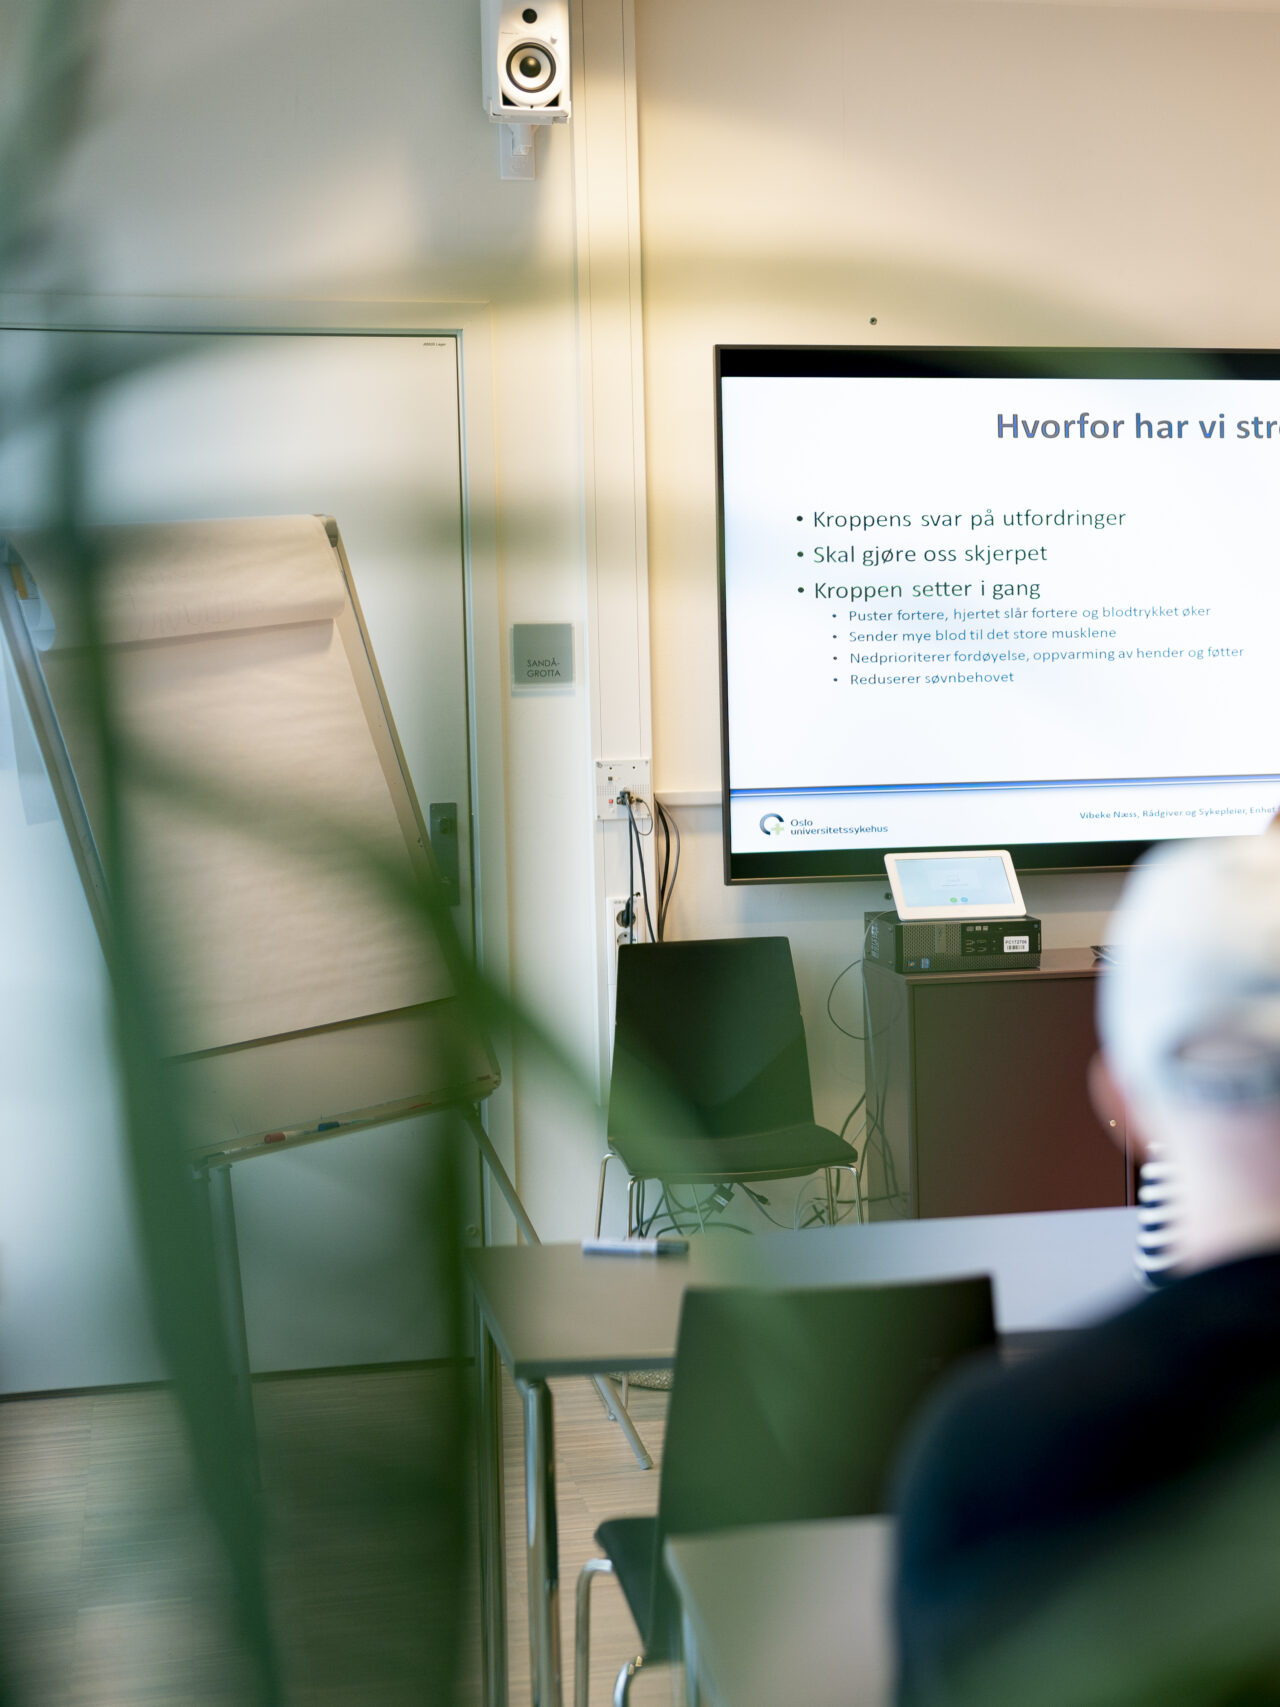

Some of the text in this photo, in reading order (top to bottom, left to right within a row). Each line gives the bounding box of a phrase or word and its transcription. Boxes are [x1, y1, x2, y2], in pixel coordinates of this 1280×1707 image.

[997, 412, 1125, 439] Hvorfor
[1135, 412, 1189, 439] har
[1199, 413, 1225, 439] vi
[814, 509, 1126, 531] Kroppens svar på utfordringer
[813, 544, 1047, 567] Skal gjøre oss skjerpet
[815, 580, 1040, 602] Kroppen setter i gang
[849, 605, 1211, 622] Puster fortere, hjertet slår fortere og blodtrykket øker
[849, 627, 1117, 643] Sender mye blod til det store musklene
[527, 657, 560, 667] SANDÅ-
[850, 646, 1244, 666] Nedprioriterer fordøyelse, oppvarming av hender og føtter
[527, 669, 561, 678] GROTTA
[851, 671, 1015, 685] Reduserer søvnbehovet
[1080, 811, 1111, 819] Vibeke
[1113, 811, 1140, 819] Næss,
[1142, 809, 1183, 818] Rådgiver
[1199, 807, 1248, 816] Sykepleier,
[790, 819, 813, 827] Oslo
[790, 825, 889, 835] universitetssykehus
